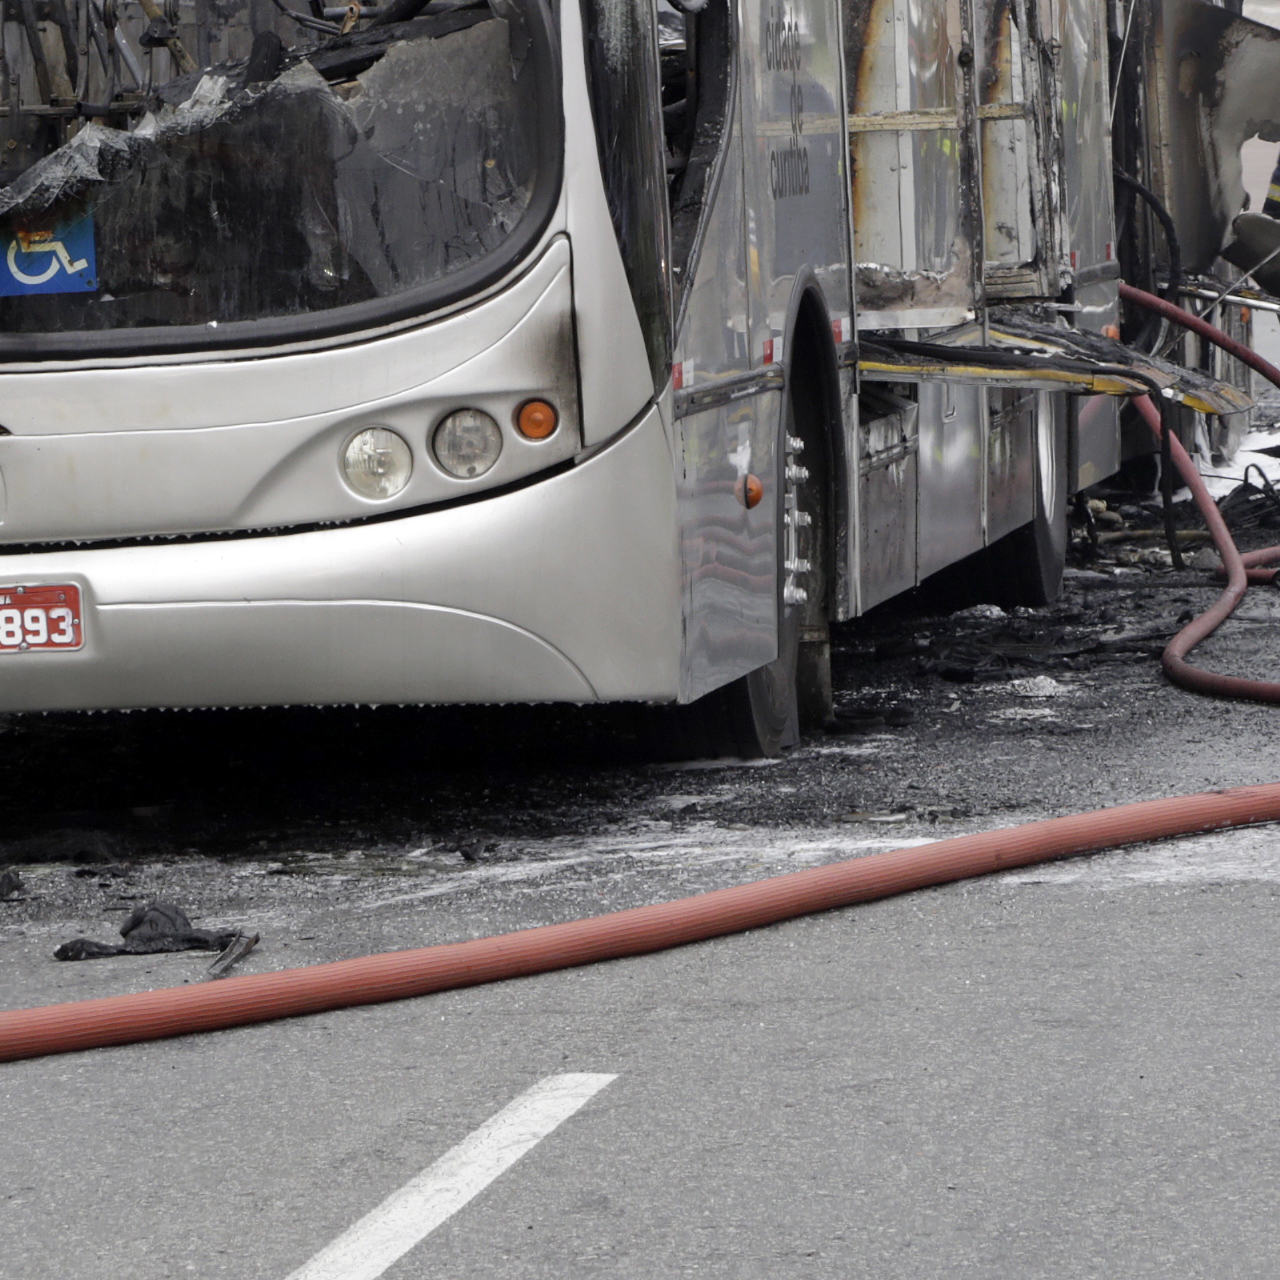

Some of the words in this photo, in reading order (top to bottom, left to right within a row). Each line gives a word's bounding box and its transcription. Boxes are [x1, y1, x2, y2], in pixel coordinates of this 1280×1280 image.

[766, 6, 801, 71] cidade
[789, 69, 804, 135] de
[770, 127, 810, 201] curitiba
